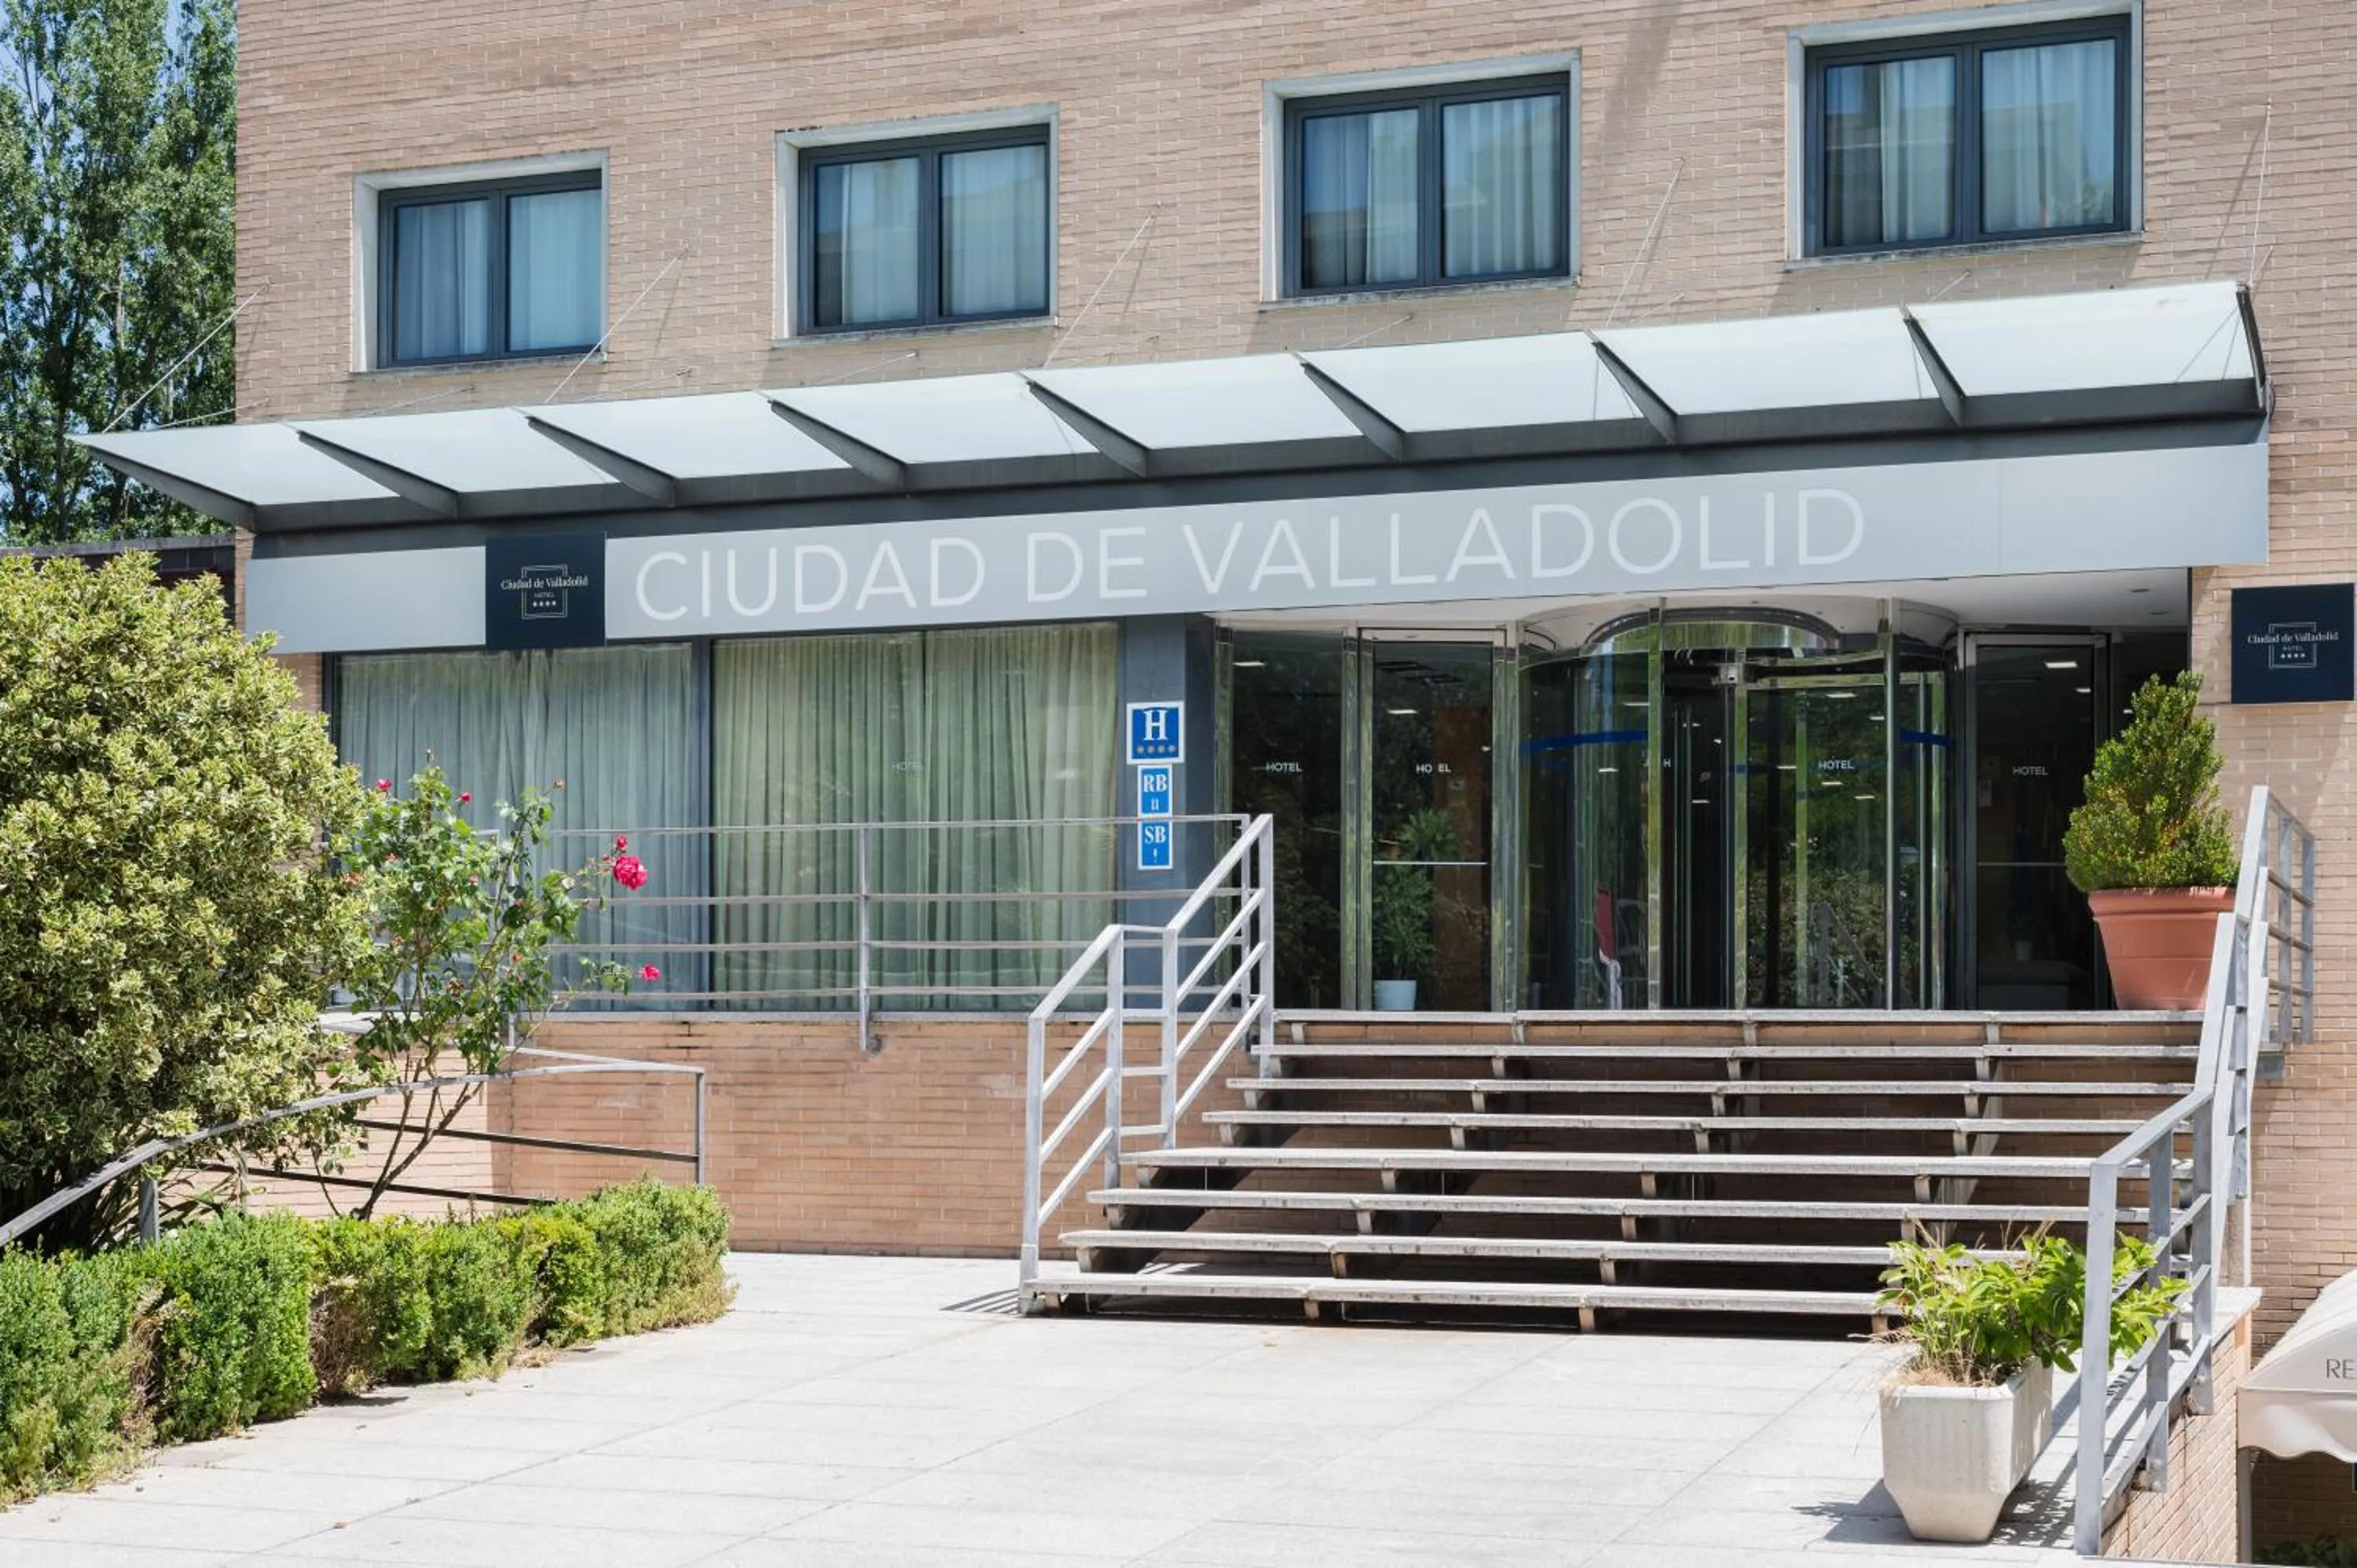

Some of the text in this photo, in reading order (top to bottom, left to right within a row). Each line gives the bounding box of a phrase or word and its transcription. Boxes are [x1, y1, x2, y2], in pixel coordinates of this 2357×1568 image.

[635, 488, 1865, 621] CIUDAD DE VALLADOLID
[500, 575, 589, 590] Ciudad de Valladolid
[2247, 631, 2340, 644] Ciudad de Valladolid
[1142, 709, 1169, 741] H
[1266, 761, 1303, 772] HOTEL
[1416, 763, 1453, 774] HOEL
[1818, 760, 1855, 770] HOTEL
[2012, 766, 2049, 775] HOTEL
[1143, 774, 1168, 793] RB
[1144, 826, 1167, 844] SB
